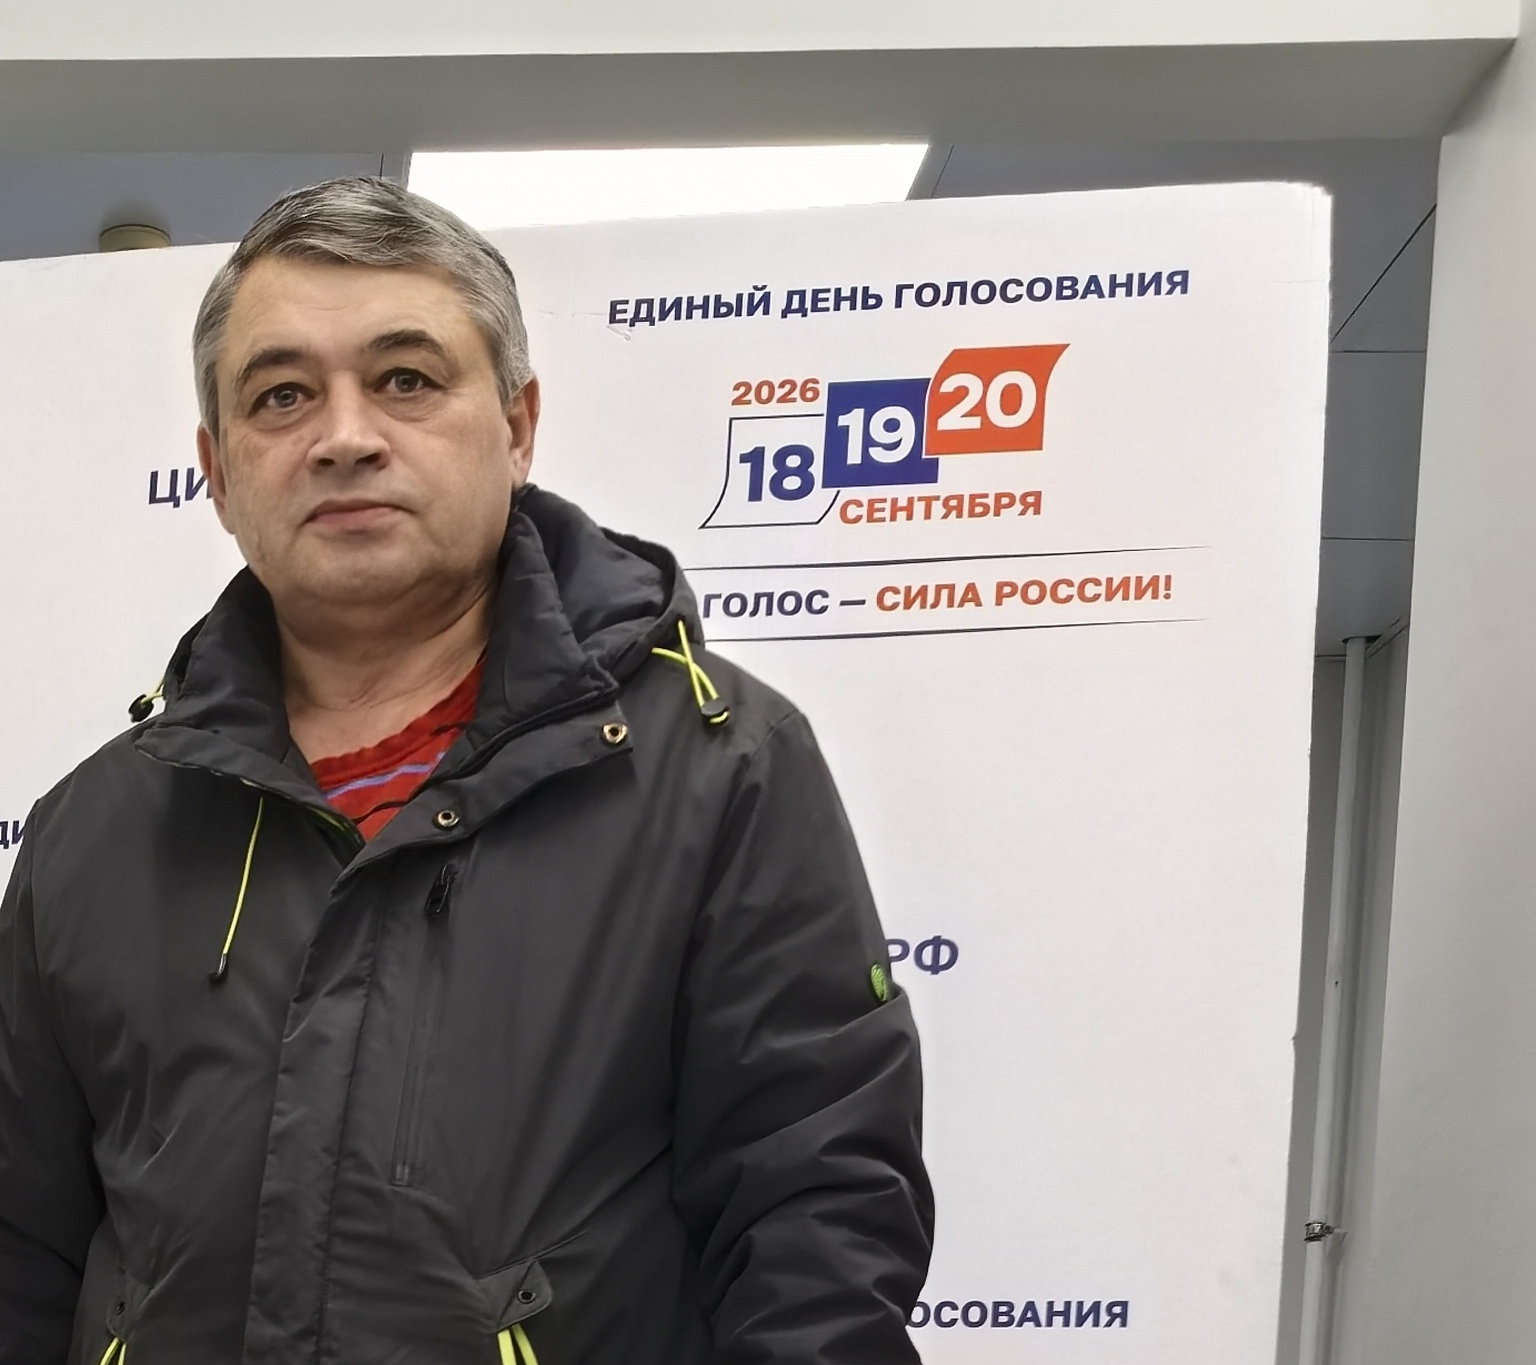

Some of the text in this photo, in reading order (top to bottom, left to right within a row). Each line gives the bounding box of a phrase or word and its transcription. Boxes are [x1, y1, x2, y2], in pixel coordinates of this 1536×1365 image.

[608, 269, 1190, 328] ЕДИНЫЙ ДЕНЬ ГОЛОСОВАНИЯ
[731, 377, 820, 406] 2026
[935, 370, 1038, 431] 20
[837, 405, 916, 465] 19
[738, 444, 816, 503] 18
[839, 490, 1043, 525] СЕНТЯБРЯ
[702, 589, 830, 619] ГОЛОС
[876, 582, 983, 612] СИЛА
[994, 574, 1172, 607] РОССИИ!
[908, 1299, 1130, 1330] ОСОВАНИЯ
